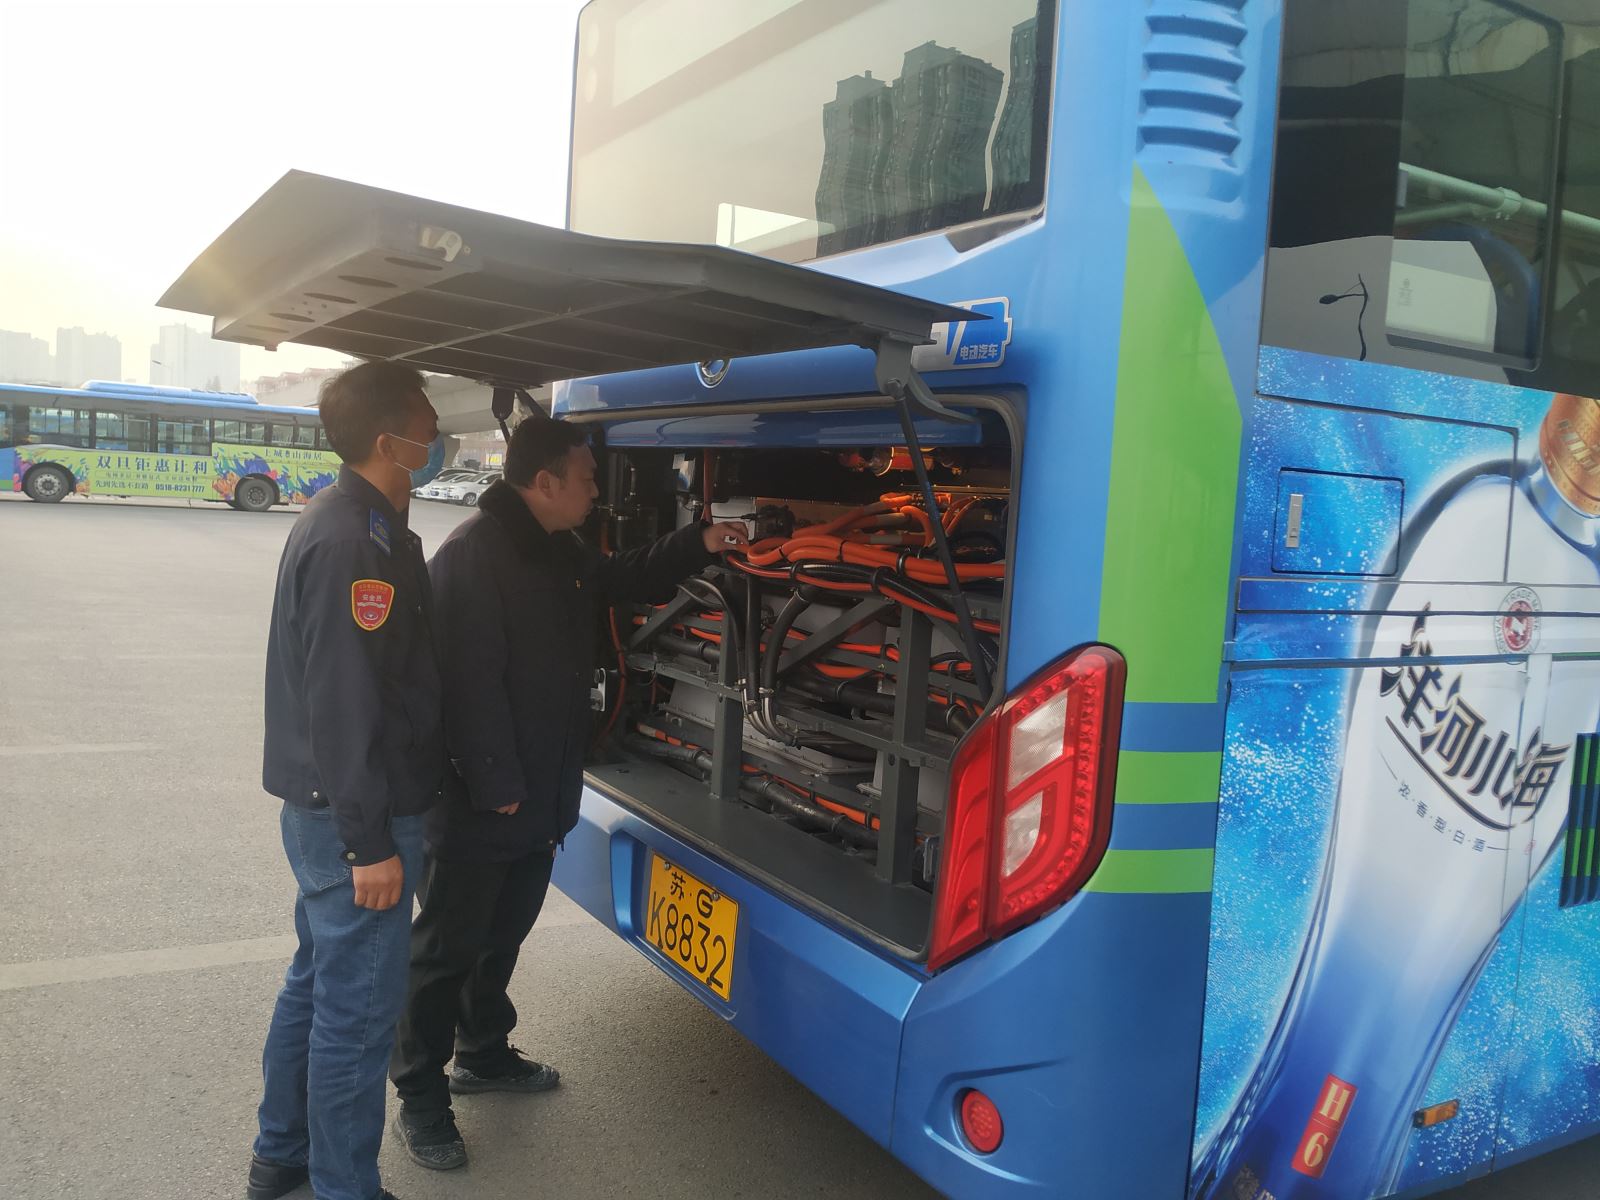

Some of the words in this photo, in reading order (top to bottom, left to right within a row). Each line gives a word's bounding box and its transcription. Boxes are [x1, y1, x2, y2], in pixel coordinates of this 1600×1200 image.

[960, 344, 998, 360] 电动汽车
[650, 891, 727, 989] K8832
